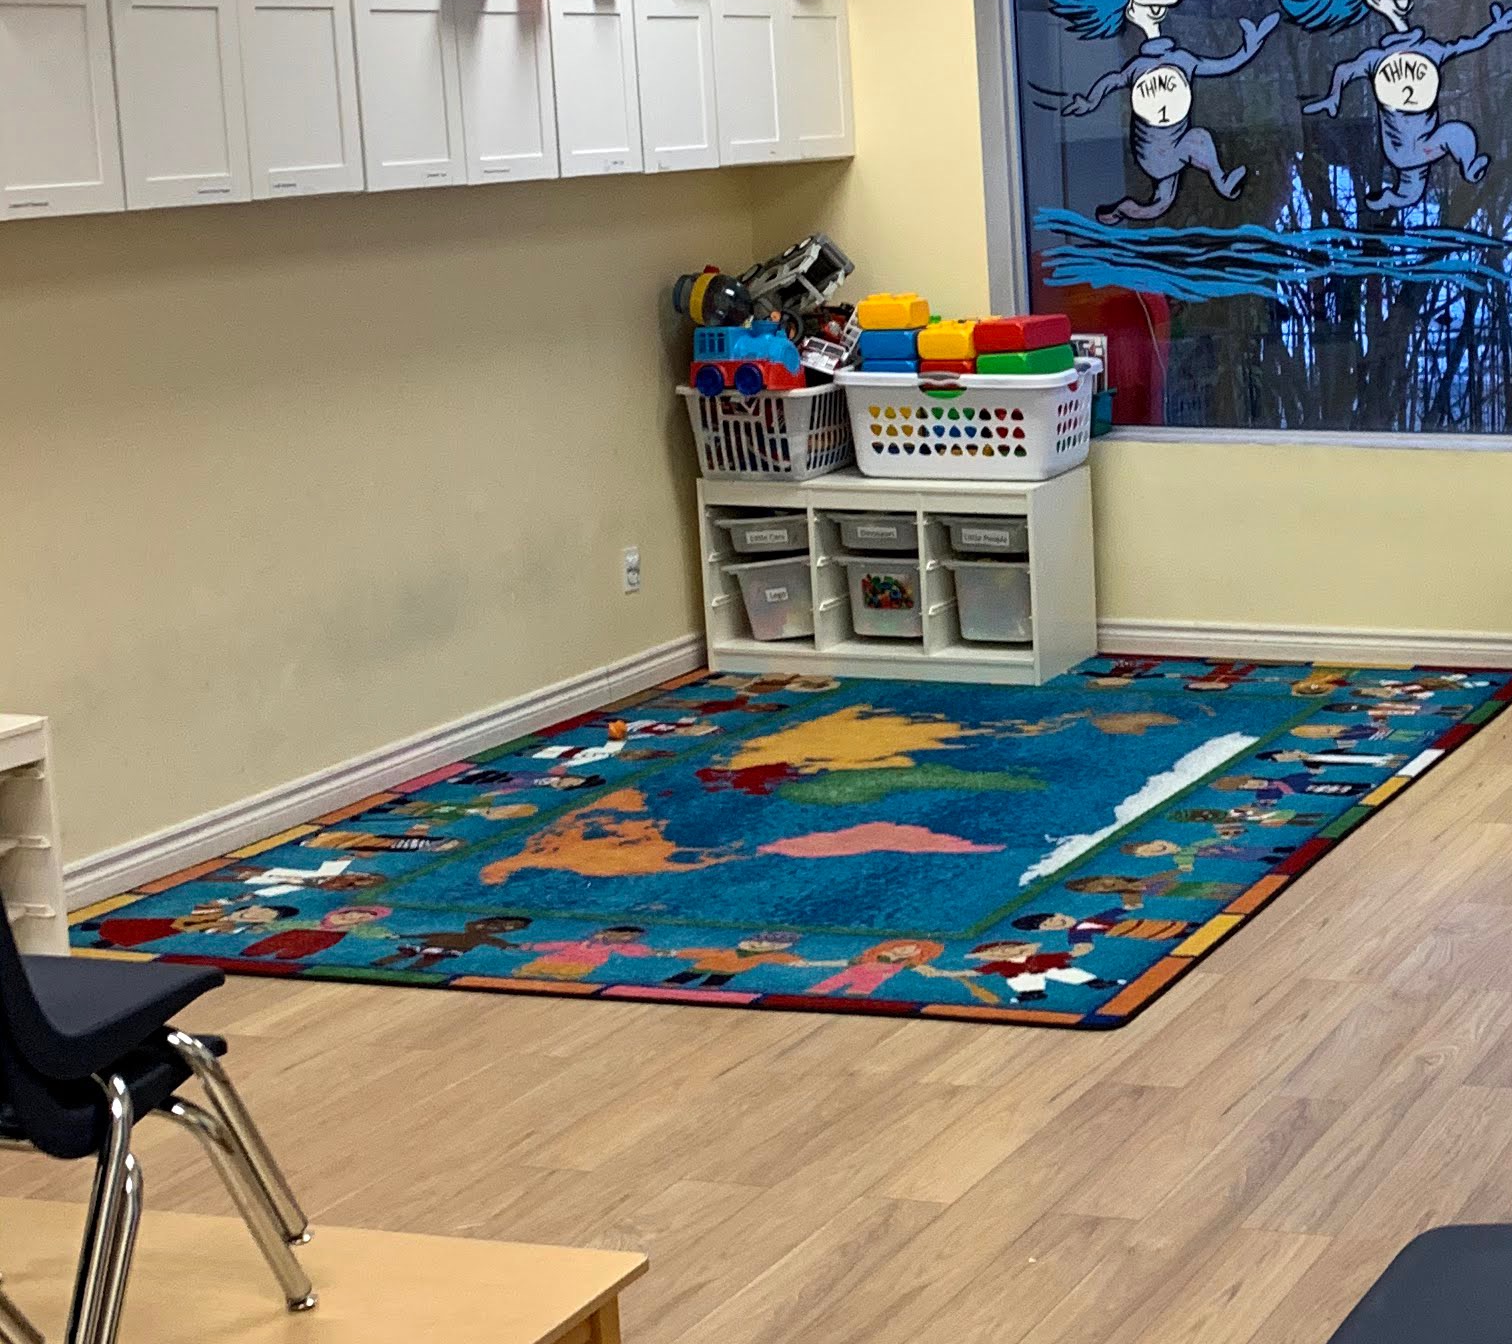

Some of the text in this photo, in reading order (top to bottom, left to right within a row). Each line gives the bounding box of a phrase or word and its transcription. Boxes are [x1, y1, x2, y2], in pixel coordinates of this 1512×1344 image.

[1379, 58, 1428, 83] THING
[1137, 74, 1177, 101] THING
[1402, 86, 1418, 105] 2
[1158, 106, 1170, 124] 1
[769, 590, 786, 600] Lego
